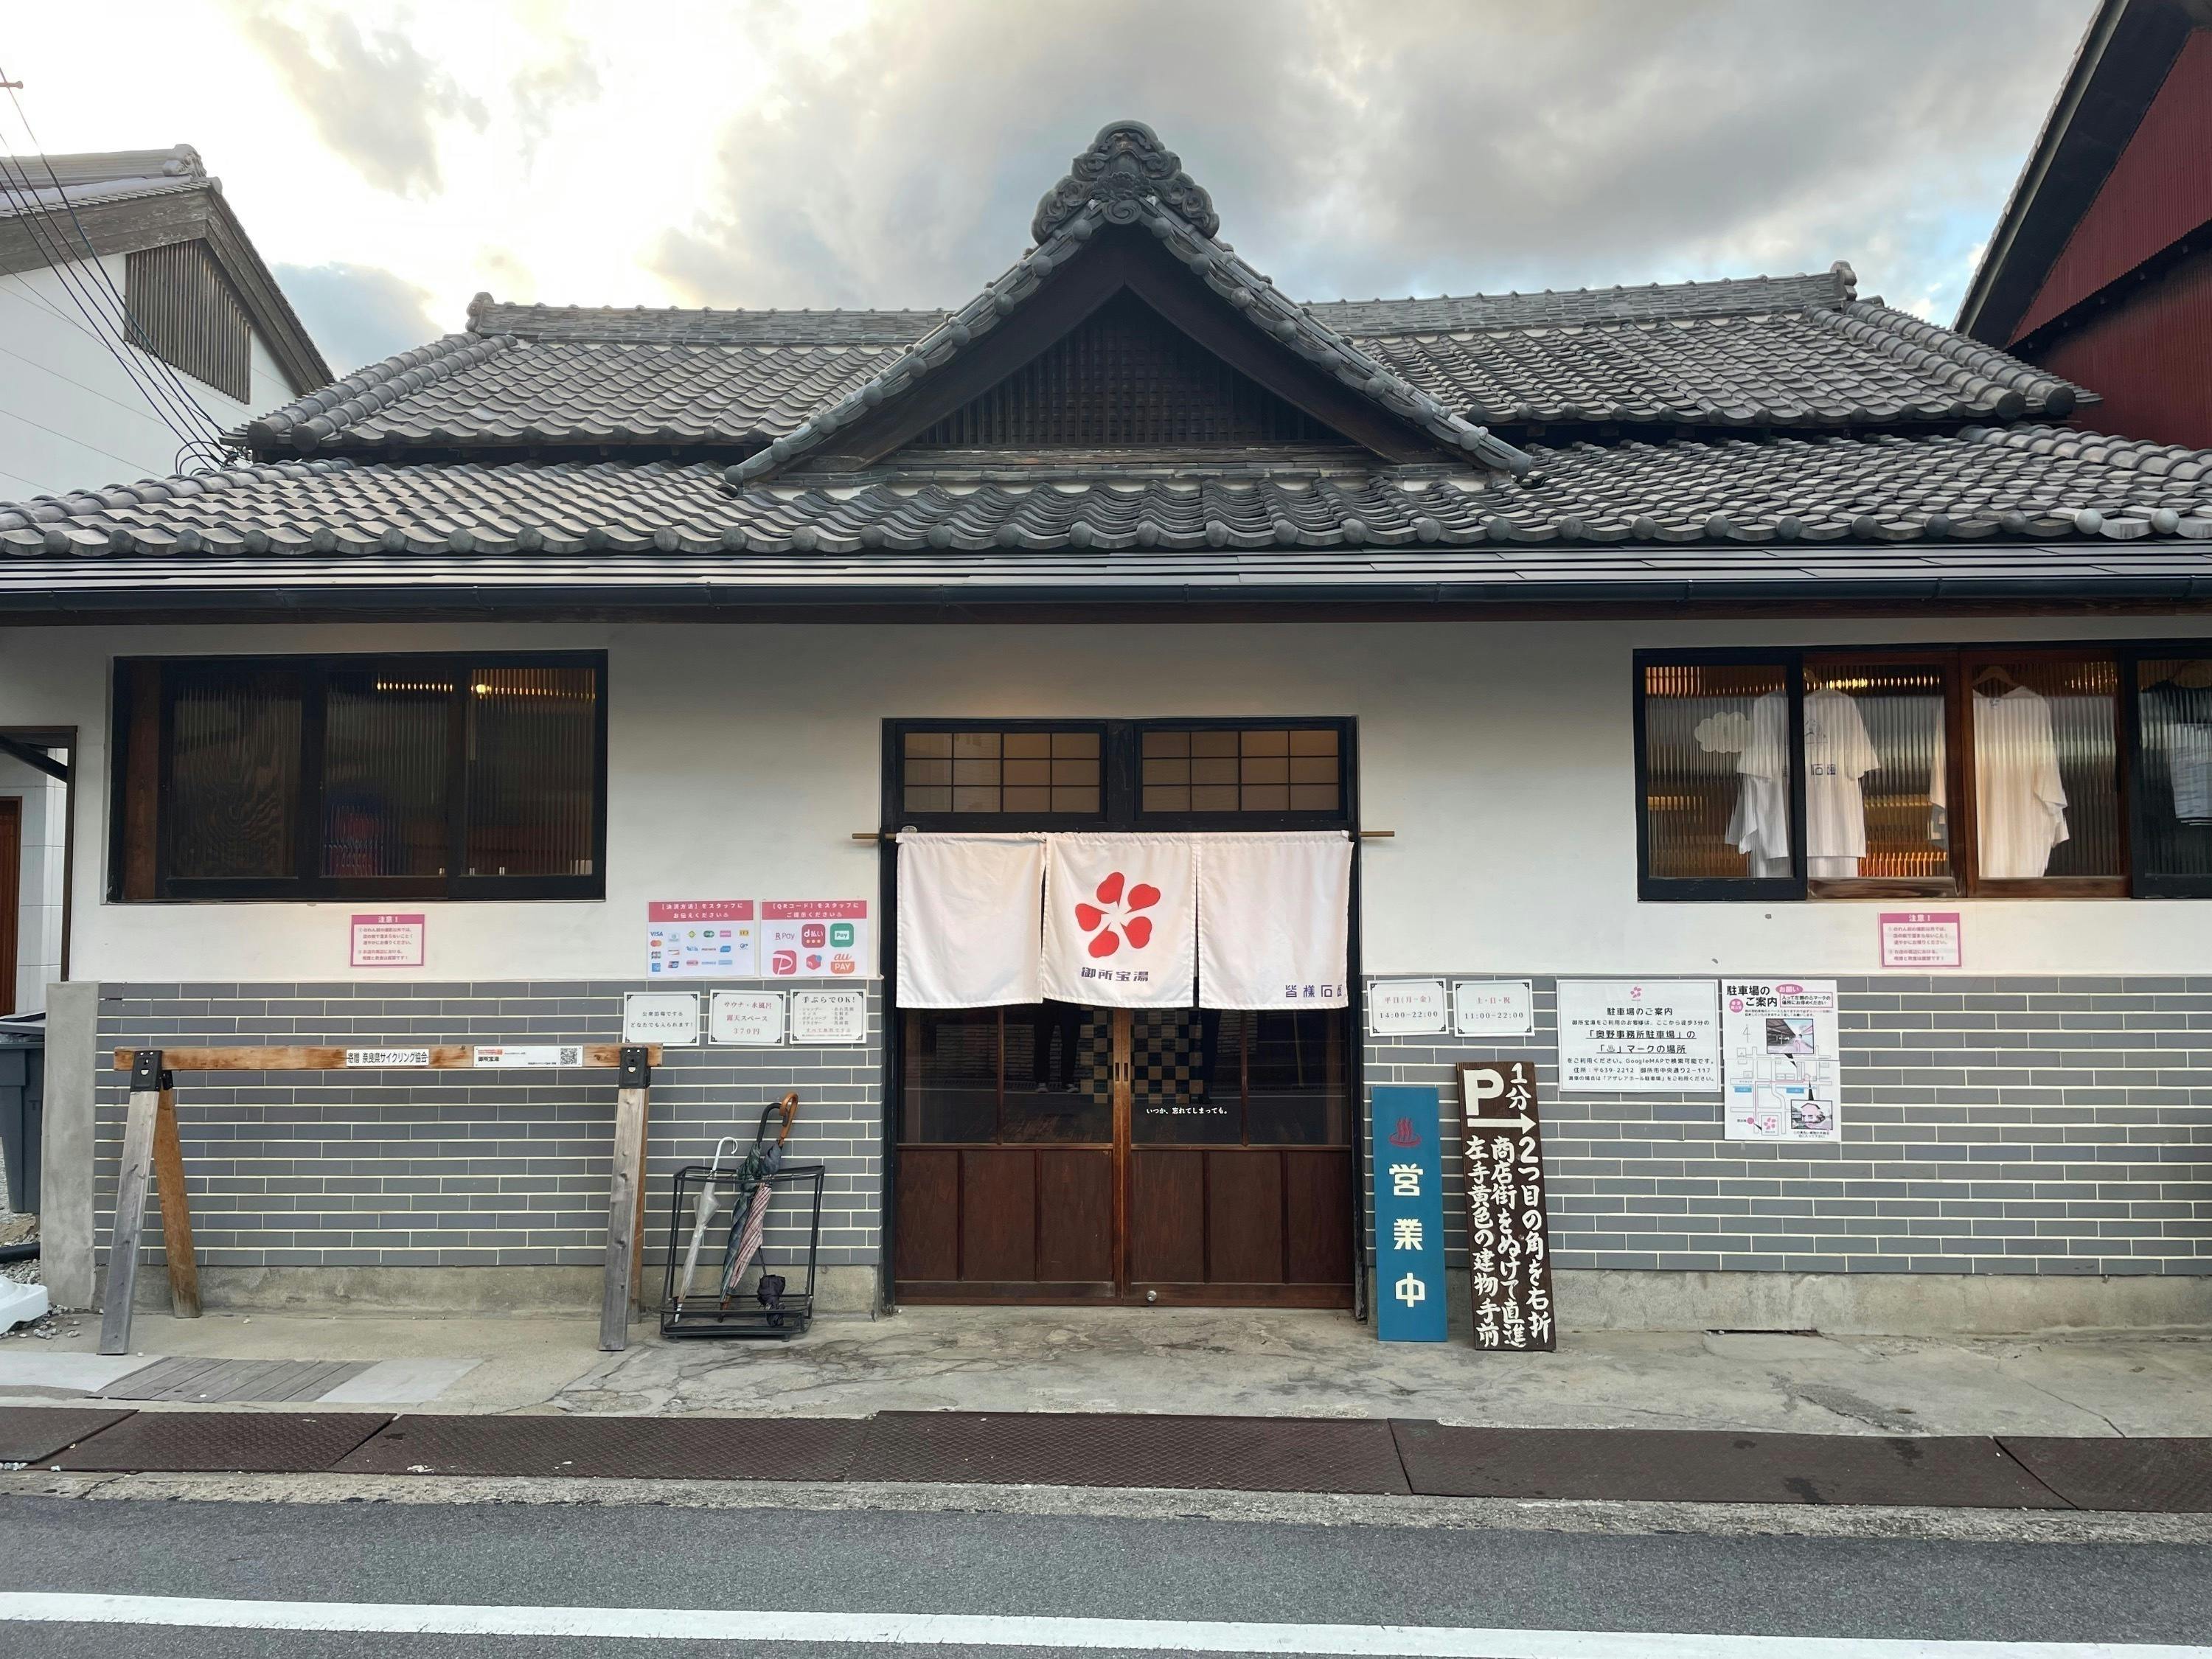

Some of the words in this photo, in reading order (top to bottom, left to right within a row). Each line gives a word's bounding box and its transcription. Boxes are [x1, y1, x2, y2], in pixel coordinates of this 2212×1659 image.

[782, 932, 795, 941] Pay
[804, 930, 824, 938] d払い
[1081, 967, 1149, 982] 御所宝湯
[1727, 986, 1770, 995] 駐車場の
[1746, 997, 1778, 1007] ご案内
[1607, 1008, 1673, 1016] 駐車場のご案内
[1589, 1030, 1695, 1039] 「奥野事務所駐車場」の
[362, 1051, 427, 1062] 奈良県サイクリング協会
[1463, 1069, 1504, 1116] P
[1505, 1062, 1531, 1110] 1分
[1389, 1163, 1425, 1307] 営業中
[1465, 1135, 1501, 1348] 左手黄色の建物手前
[1490, 1135, 1526, 1348] 商店街をぬけて直進
[1517, 1135, 1551, 1344] 2つ目の角を右折
